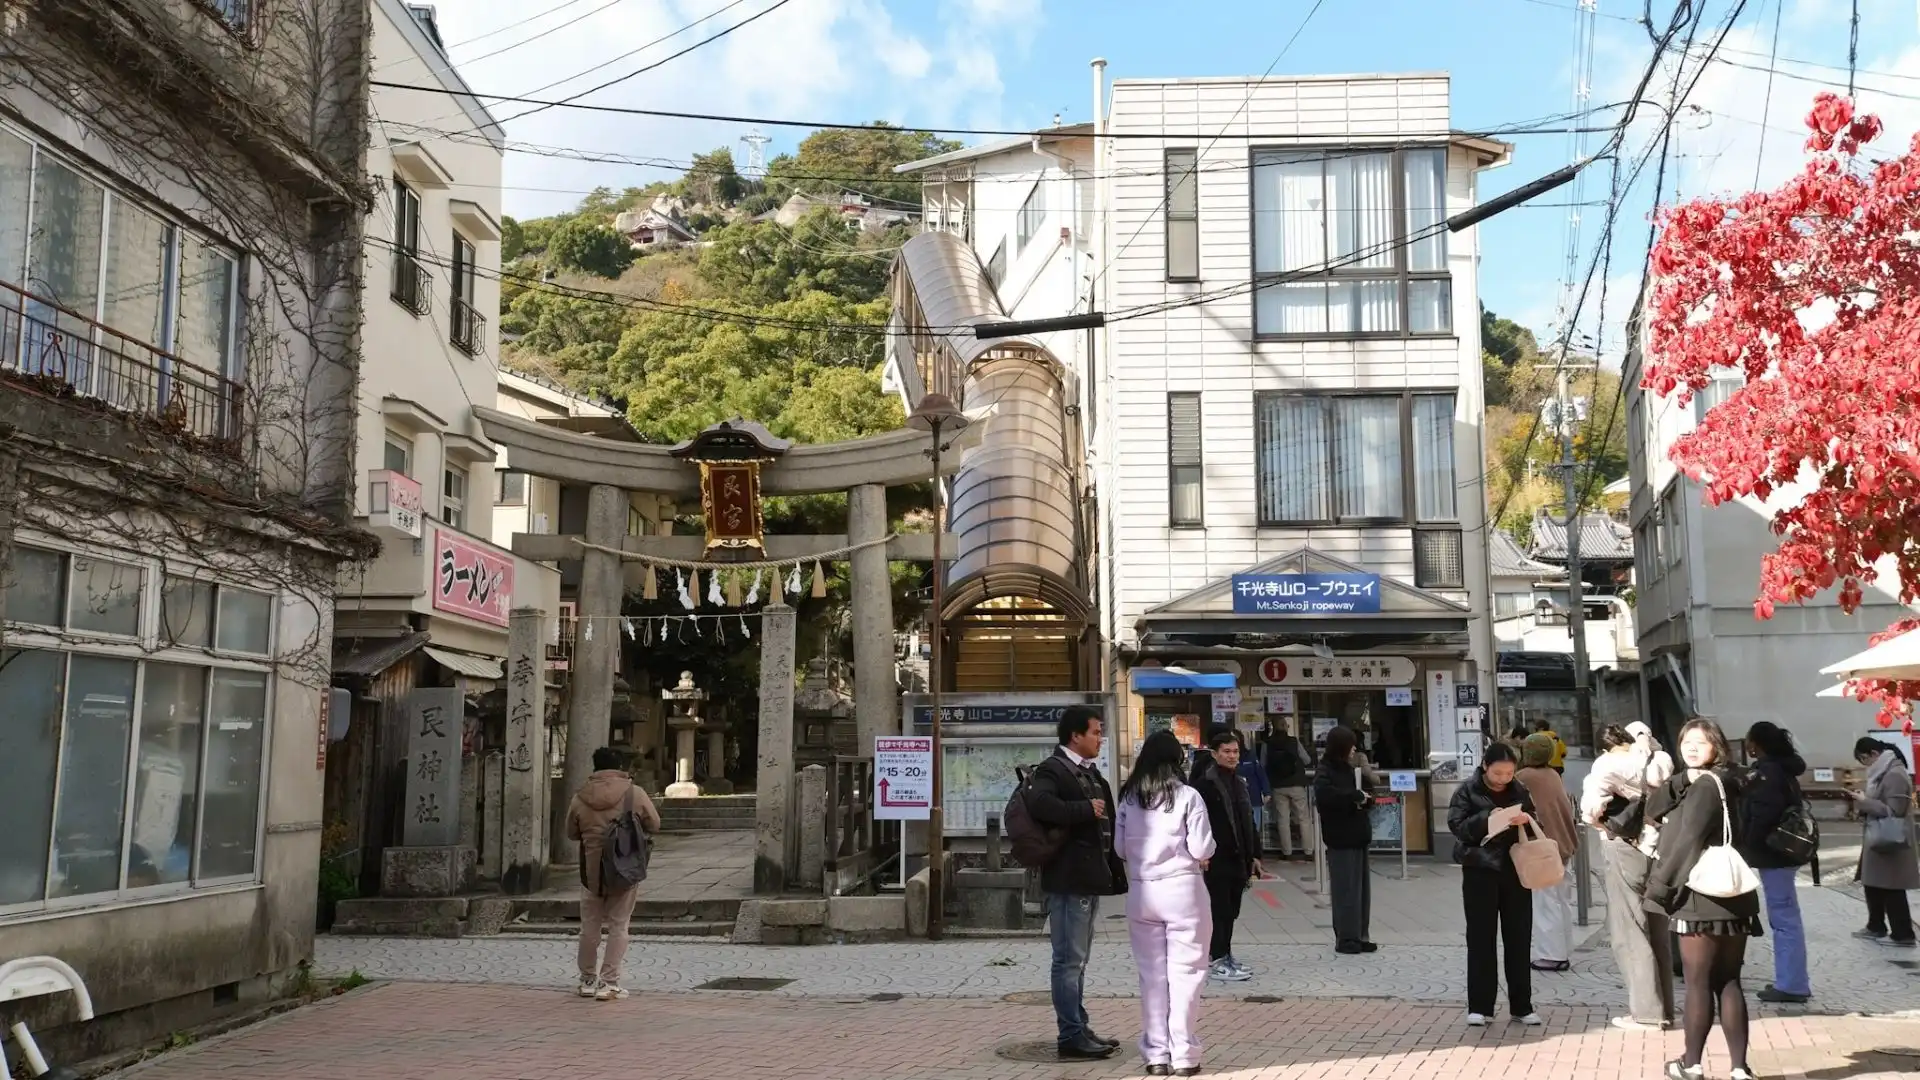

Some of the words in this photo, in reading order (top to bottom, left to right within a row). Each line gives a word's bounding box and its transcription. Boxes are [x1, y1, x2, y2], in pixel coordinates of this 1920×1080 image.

[441, 548, 490, 608] ラーメン
[1237, 580, 1376, 597] 千光寺山ロープウェイ
[1256, 600, 1309, 612] Mt.Senkoji
[1311, 601, 1355, 611] ropeway
[1302, 667, 1392, 678] 観光案内所
[1462, 743, 1474, 766] 入口
[414, 706, 446, 824] 艮神社
